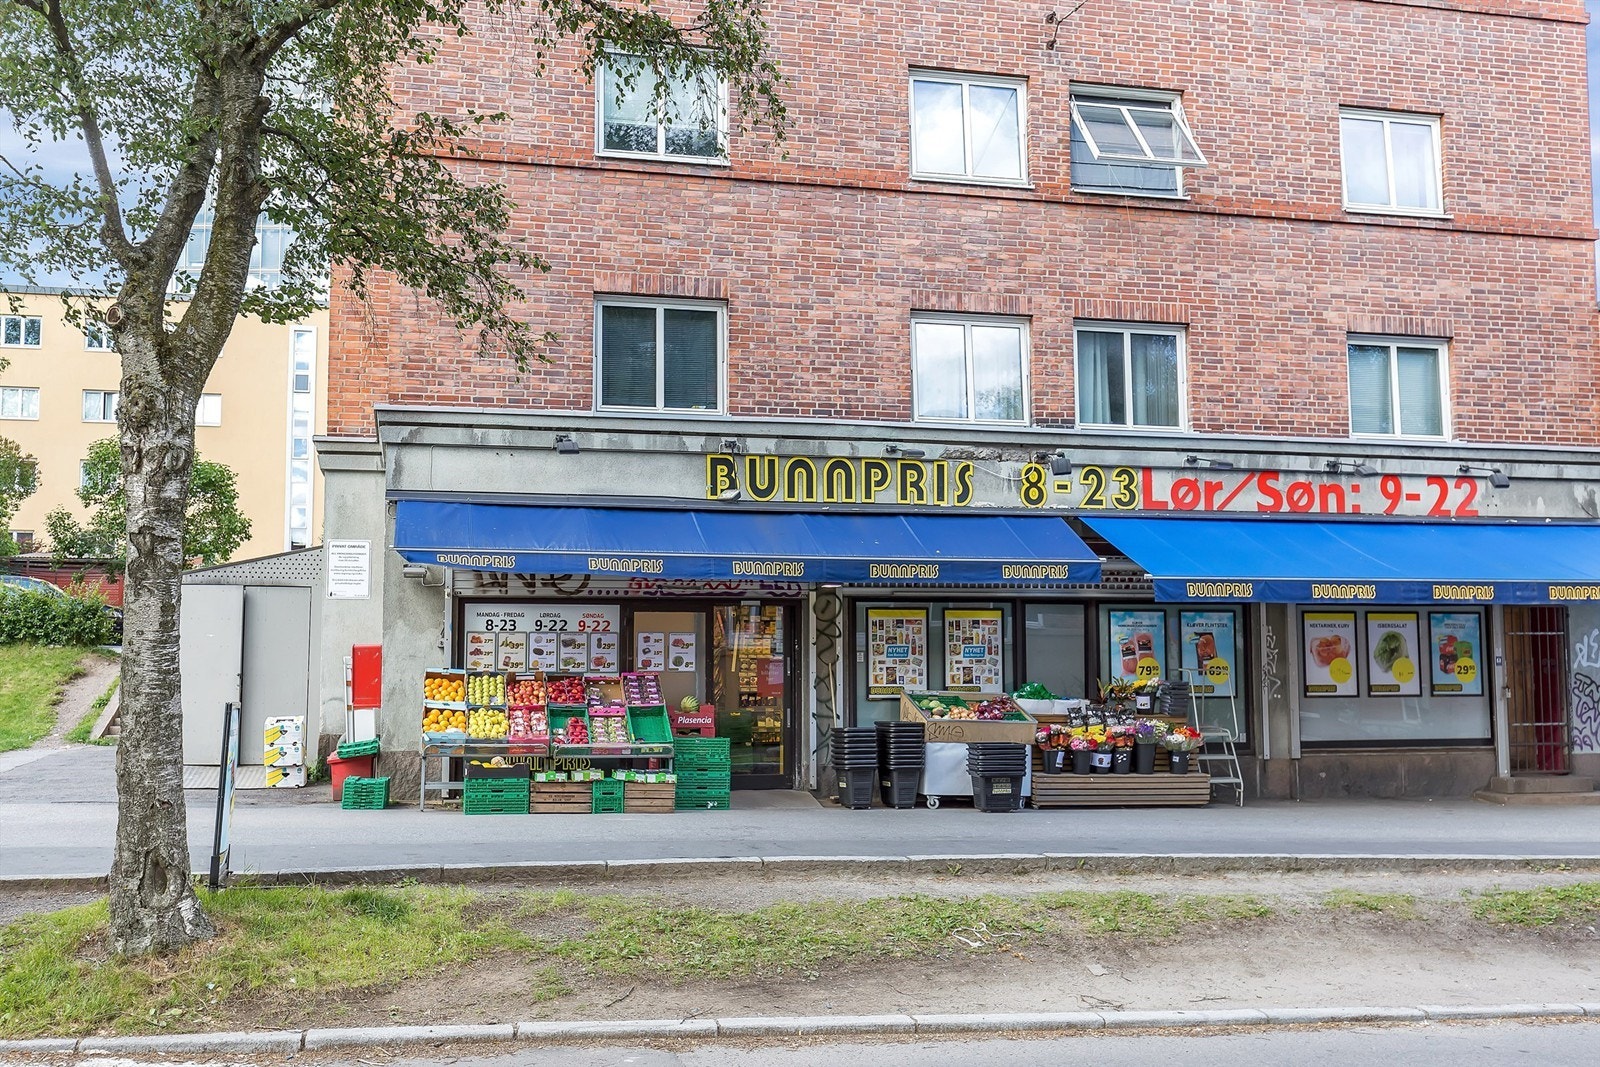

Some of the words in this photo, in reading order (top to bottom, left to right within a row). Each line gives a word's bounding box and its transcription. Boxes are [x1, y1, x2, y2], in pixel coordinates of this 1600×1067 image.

[706, 454, 973, 507] BUNNPRIS
[1380, 475, 1479, 517] 9-22
[436, 554, 516, 568] BUNNPRIS
[588, 557, 664, 574] BUNNPRIS
[732, 560, 804, 576] BUNNPRIS
[870, 564, 939, 578] BUNNPRIS
[1002, 564, 1068, 579] BUNNPRIS
[1186, 582, 1253, 598] BUNNPRIS
[1312, 584, 1376, 599] BUNNPRIS
[1432, 585, 1494, 600] BUNNPRIS
[486, 620, 516, 632] 8-23
[534, 620, 568, 632] 9-22
[578, 620, 610, 632] 9-22
